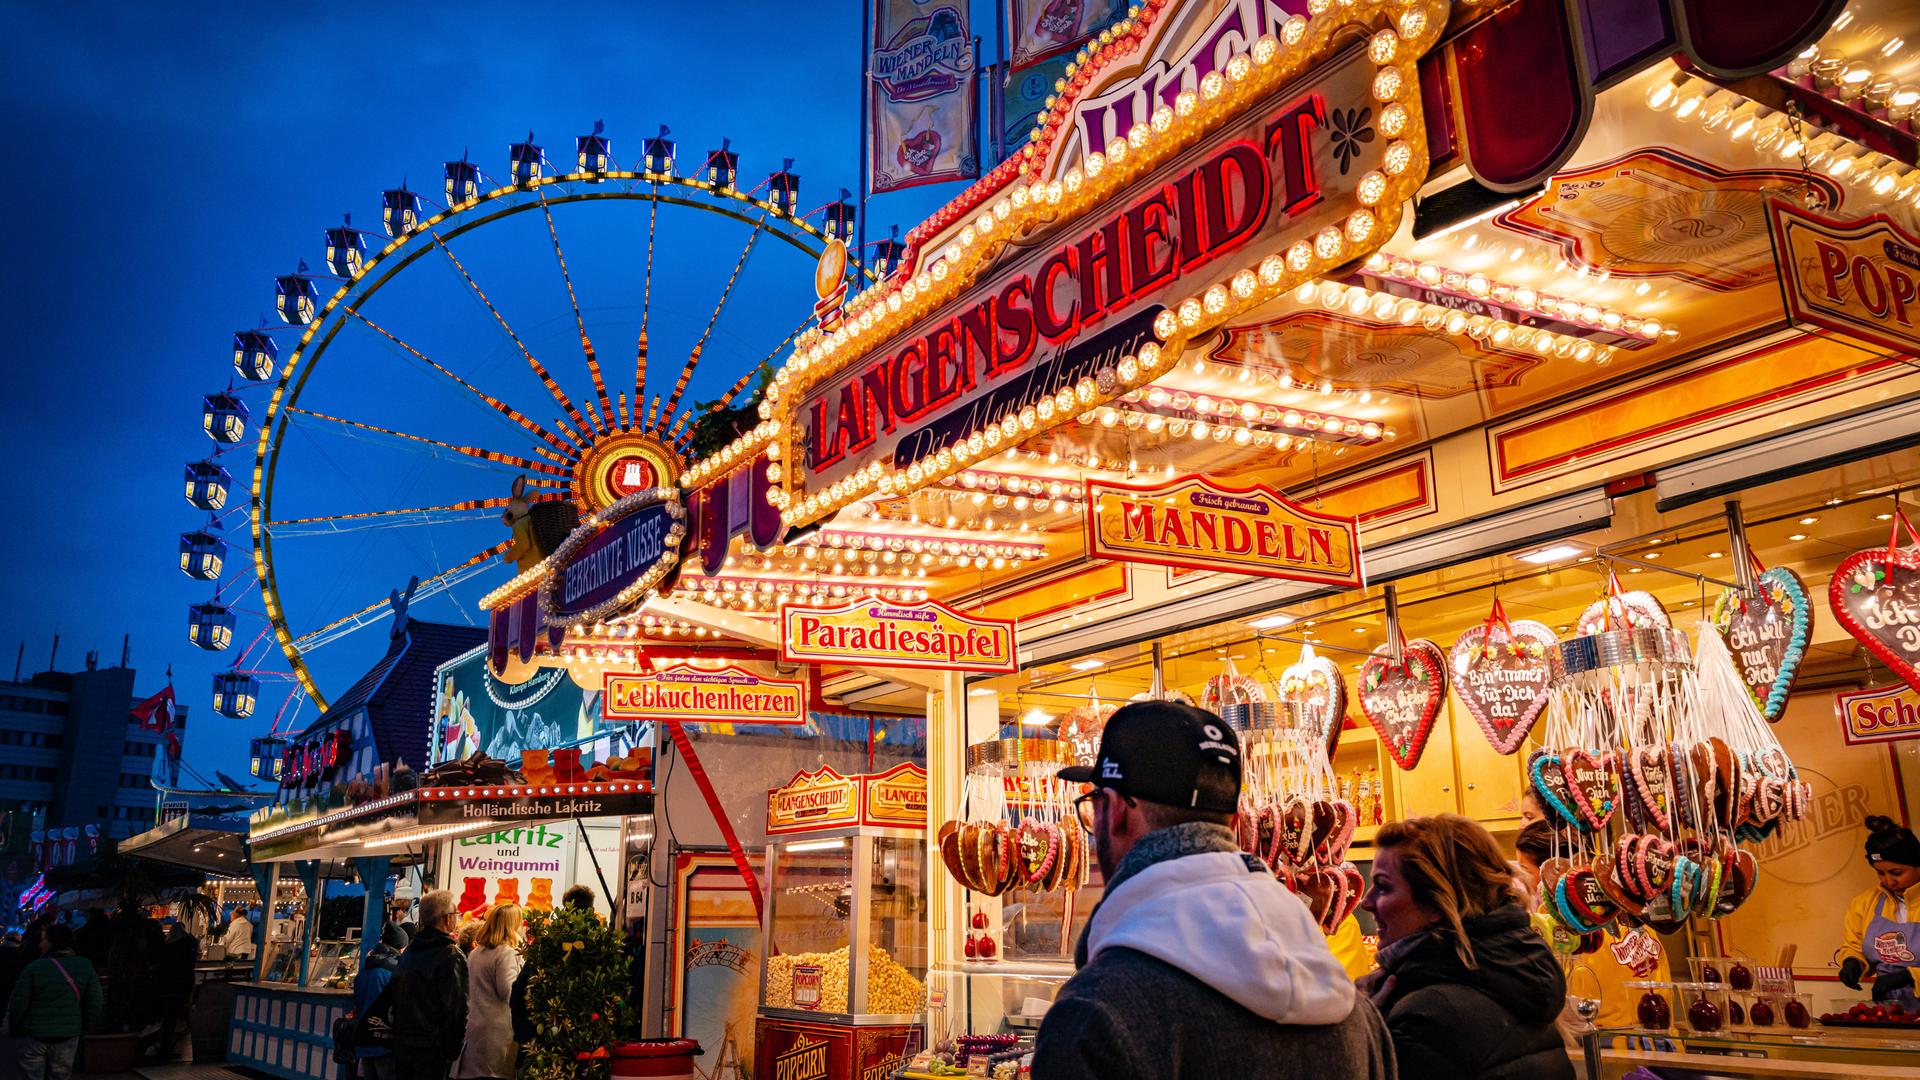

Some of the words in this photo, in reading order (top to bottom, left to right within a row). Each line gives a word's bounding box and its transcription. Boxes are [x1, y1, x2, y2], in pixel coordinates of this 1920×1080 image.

[880, 41, 933, 73] WIENER
[896, 42, 960, 80] MANDELN
[811, 95, 1330, 474] LANGENSCHEIDT
[1815, 239, 1920, 329] POP
[913, 427, 950, 462] Der
[960, 331, 1146, 440] Mandelbrenner
[1199, 494, 1223, 507] Frisch
[1224, 500, 1262, 513] gebrannte
[1120, 502, 1336, 567] MANDELN
[565, 537, 623, 603] GEBRANNTE
[626, 513, 662, 573] NÜSSE
[1867, 599, 1919, 630] Ich
[799, 616, 1003, 663] Paradiesäpfel
[1730, 627, 1758, 650] Ich
[1759, 620, 1786, 642] will
[1741, 645, 1771, 668] nur
[1468, 668, 1494, 687] Bin
[1494, 667, 1545, 685] immer
[1744, 662, 1777, 686] Dich
[615, 682, 796, 713] Lebkuchenherzen
[1475, 684, 1500, 704] für
[1501, 684, 1538, 702] Dich
[1490, 701, 1519, 718] da!
[1857, 697, 1920, 730] Sch
[1575, 767, 1594, 784] Nur
[463, 801, 551, 818] Holländische
[555, 799, 602, 814] Lakritz
[781, 789, 844, 812] LANGENSCHEIDT
[459, 856, 560, 874] Weingummi
[497, 846, 520, 857] und
[796, 974, 819, 986] POPCORN
[776, 1046, 827, 1080] POPCORN
